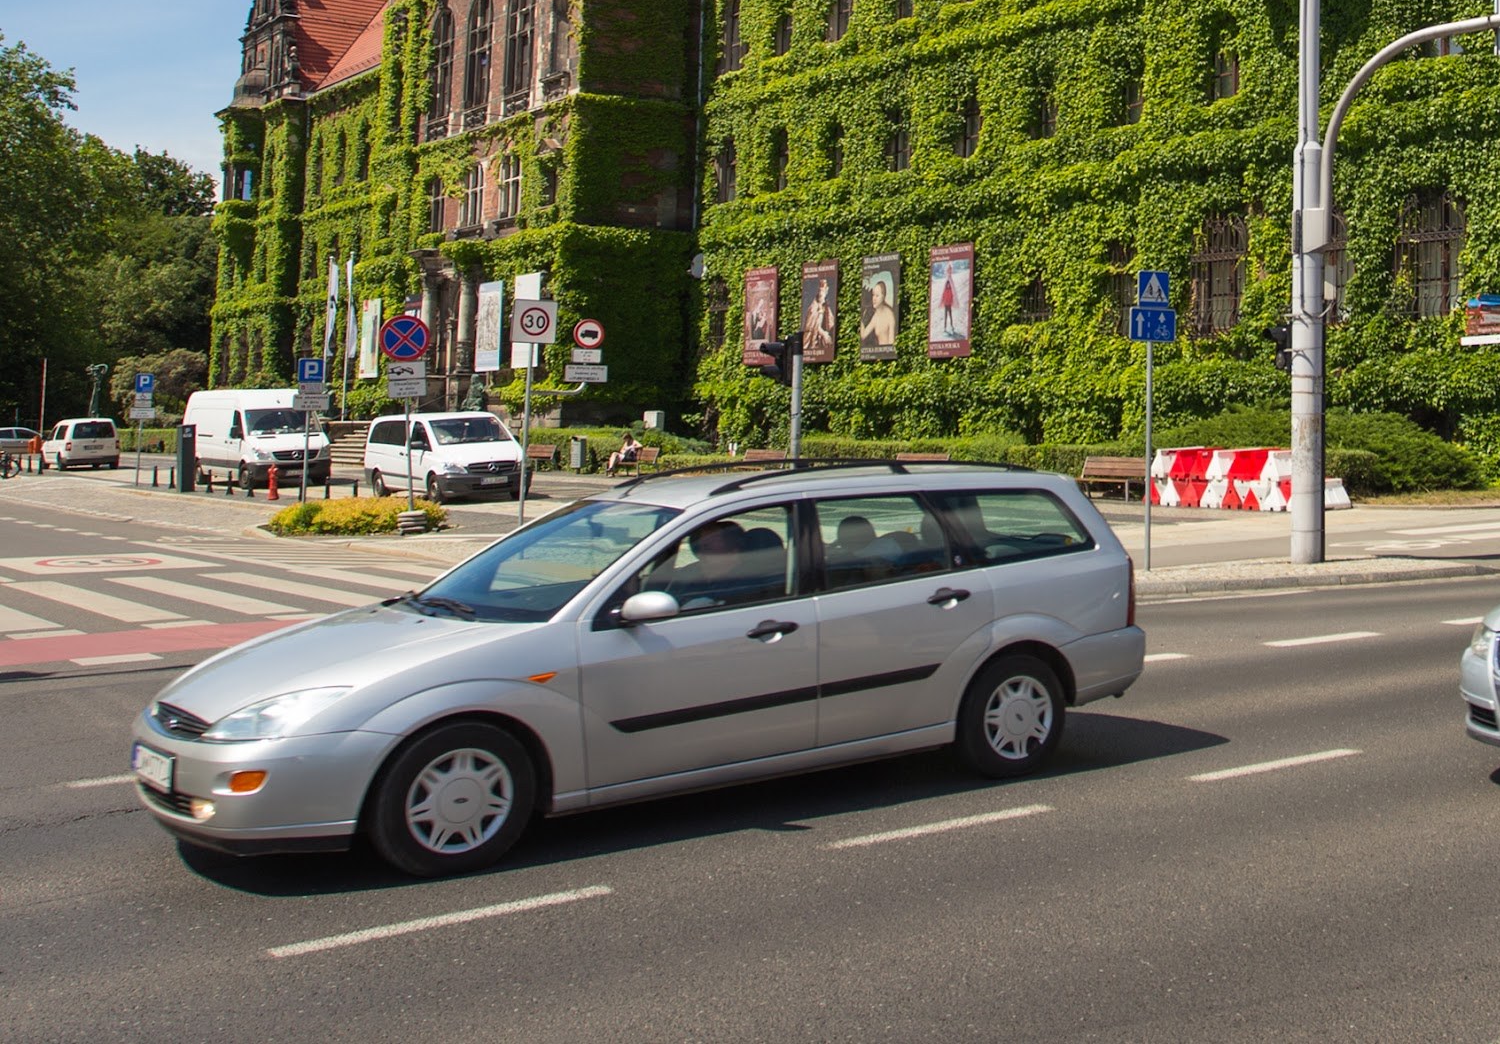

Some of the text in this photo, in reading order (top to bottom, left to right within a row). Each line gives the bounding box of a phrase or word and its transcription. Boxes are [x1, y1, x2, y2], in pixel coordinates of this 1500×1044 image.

[524, 314, 546, 329] 30
[304, 361, 319, 379] P
[139, 375, 150, 388] P
